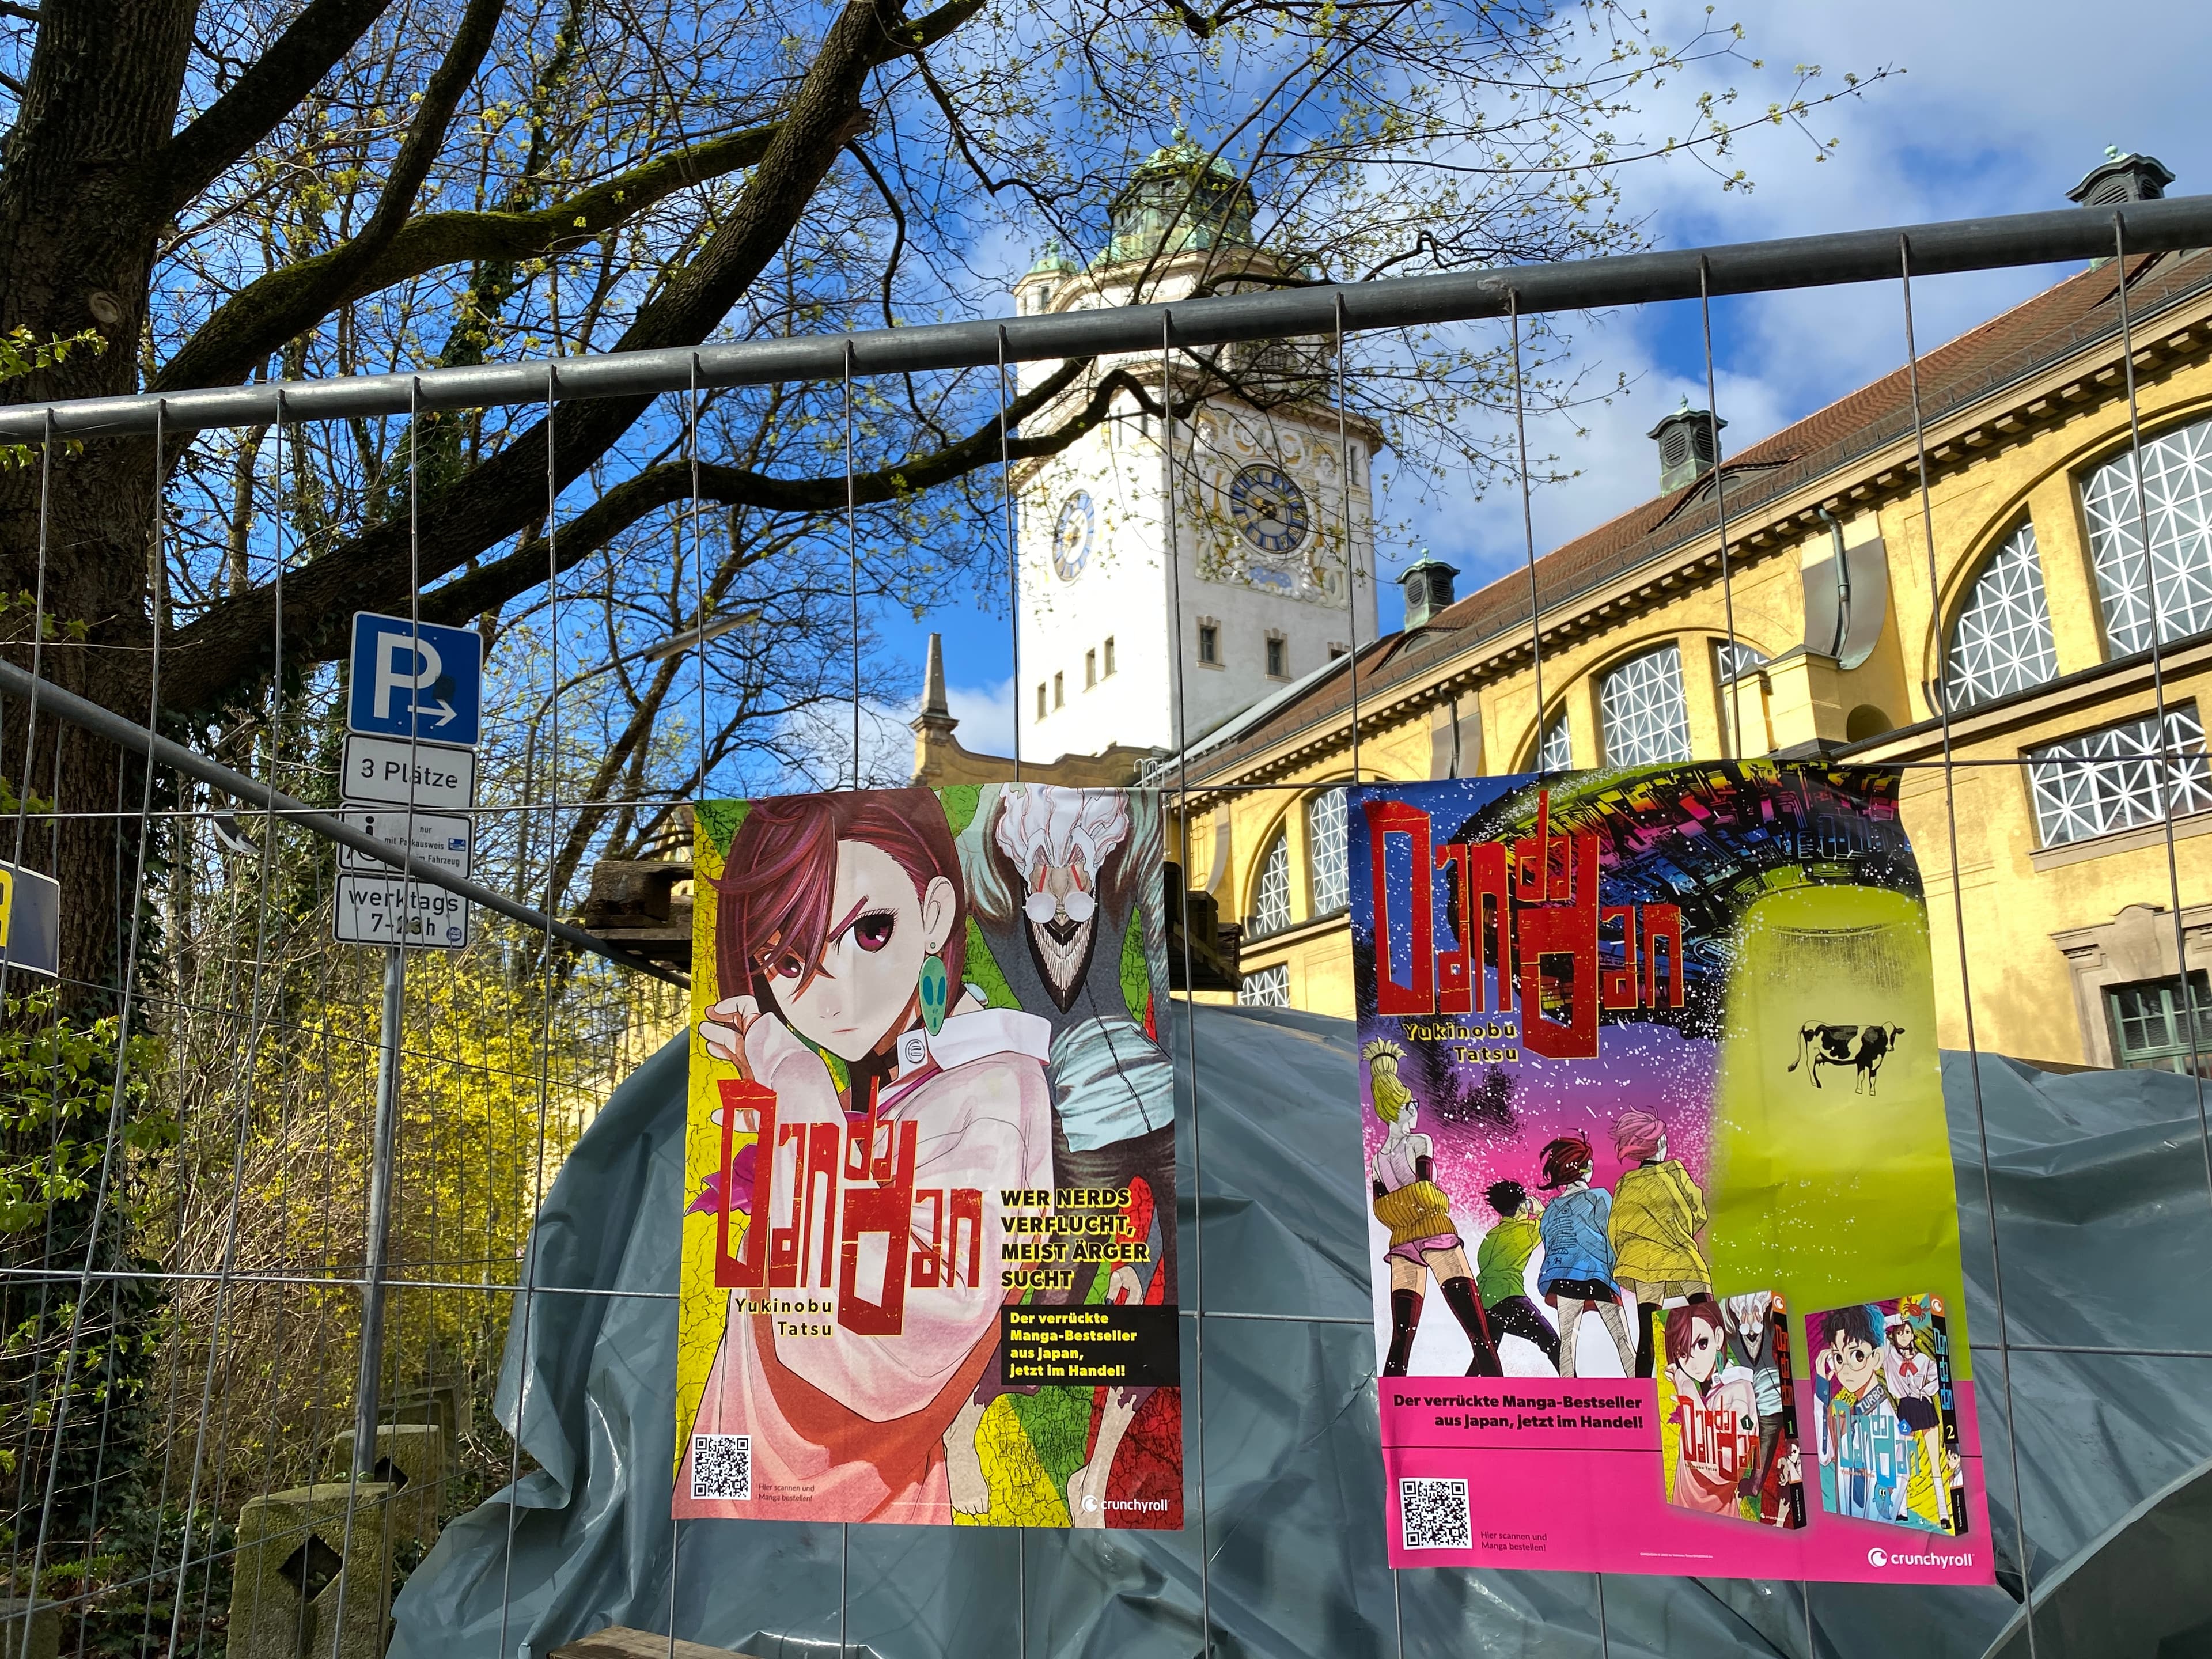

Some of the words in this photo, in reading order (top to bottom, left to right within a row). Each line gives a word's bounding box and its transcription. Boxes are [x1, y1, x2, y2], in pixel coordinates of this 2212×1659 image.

[373, 631, 442, 719] P
[361, 758, 374, 778] 3
[384, 760, 458, 789] Plätze
[399, 838, 444, 850] Pakausweis
[428, 855, 460, 868] Fahrzeug
[349, 889, 459, 916] werktags
[1403, 1022, 1517, 1041] Yukinobu
[1454, 1046, 1519, 1064] Tatsu
[1001, 1190, 1051, 1207] WER
[1056, 1188, 1132, 1208] NERDS
[1001, 1215, 1136, 1237] VERFLUCHT,
[1001, 1243, 1069, 1262] MEIST
[1071, 1238, 1151, 1262] ÄRGER
[1001, 1269, 1074, 1290] SUCHT
[735, 1298, 832, 1314] Yukinobu
[1010, 1312, 1035, 1324] Der
[1038, 1312, 1109, 1324] verrückte
[778, 1321, 832, 1336] Tatsu
[1010, 1330, 1137, 1344] Manga-Bestseller
[1010, 1349, 1035, 1359] aus
[1037, 1347, 1084, 1361] Japan,
[1047, 1364, 1065, 1376] im
[1069, 1365, 1126, 1377] Handel!
[1393, 1394, 1421, 1406] Der
[1423, 1395, 1499, 1407] verrückte
[1502, 1395, 1642, 1410] Manga-Bestseller
[1856, 1385, 1884, 1412] TURBO
[1434, 1416, 1461, 1426] aus
[1464, 1414, 1514, 1429] Japan,
[1517, 1414, 1554, 1430] jetzt
[1557, 1415, 1577, 1428] im
[1581, 1415, 1643, 1429] Handel!
[1787, 1420, 1794, 1435] 1
[1902, 1424, 1907, 1433] 2
[1946, 1425, 1955, 1440] 2
[759, 1494, 780, 1502] Manga
[1100, 1498, 1168, 1513] crunchyroll
[1480, 1531, 1497, 1539] Hier
[1532, 1533, 1547, 1541] und
[1481, 1541, 1508, 1551] Manga
[1509, 1542, 1546, 1551] bestellen!
[1891, 1552, 1973, 1569] crunchyroll
